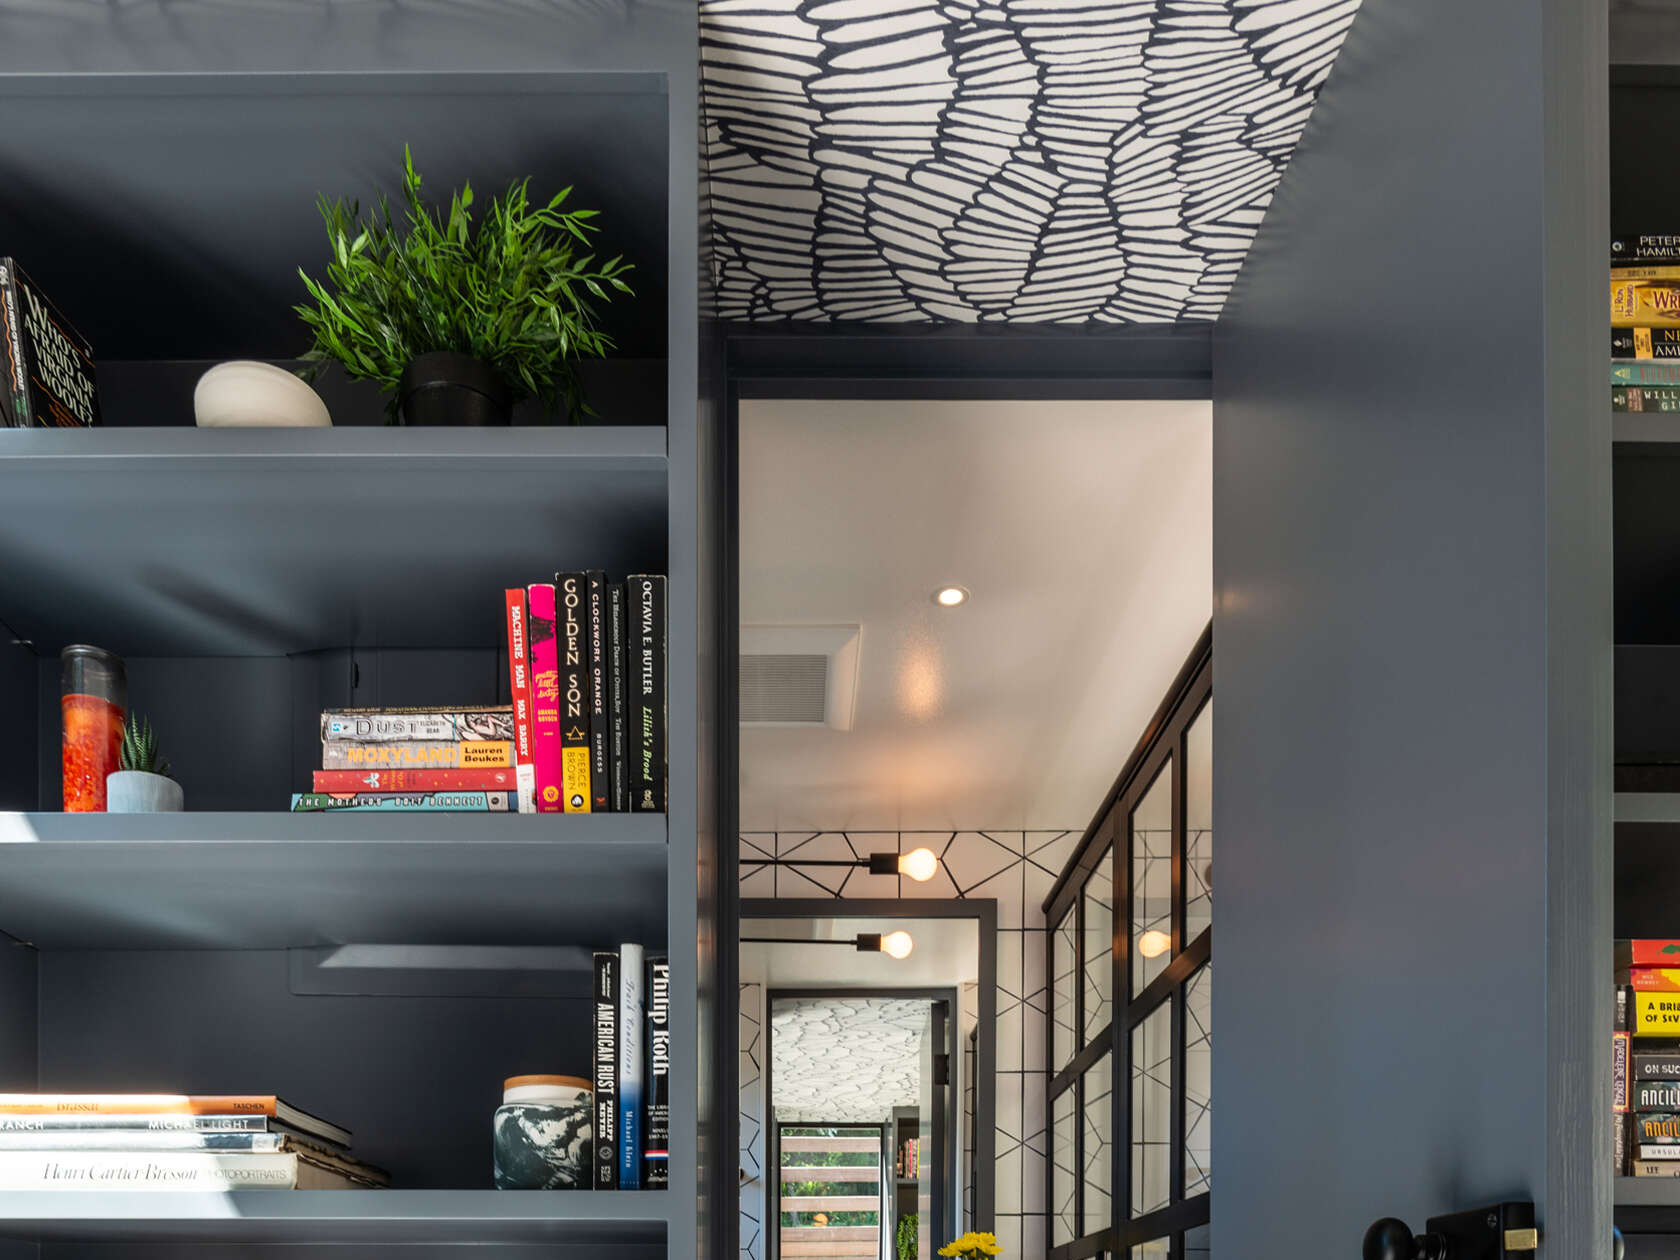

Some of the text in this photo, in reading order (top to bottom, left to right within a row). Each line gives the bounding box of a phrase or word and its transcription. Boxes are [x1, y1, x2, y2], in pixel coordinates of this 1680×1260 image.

[24, 284, 80, 369] WHO'S
[25, 313, 95, 398] AFRAID OF
[32, 338, 94, 415] VIRGINIA
[38, 360, 93, 428] WOOLF?
[563, 578, 582, 718] GOLDEN SON
[591, 593, 601, 663] CLOCKWORK
[642, 581, 654, 695] OCTAVIA E. BUTLER
[515, 664, 526, 689] MAN
[593, 667, 603, 715] ORANGE
[346, 746, 457, 763] MOXYLAND
[464, 746, 503, 755] Lauren
[643, 705, 654, 781] Lilith's Brood
[567, 751, 577, 791] BROWN
[577, 752, 587, 788] PIERCE
[647, 963, 668, 1025] Philip
[597, 1003, 615, 1063] AMERICAN
[1645, 1015, 1657, 1023] OF
[597, 1064, 615, 1095] RUST
[1644, 1064, 1659, 1074] ON
[148, 1120, 209, 1131] MICHAEL
[213, 1120, 250, 1131] LIGHT
[233, 1102, 266, 1111] TASCHEN
